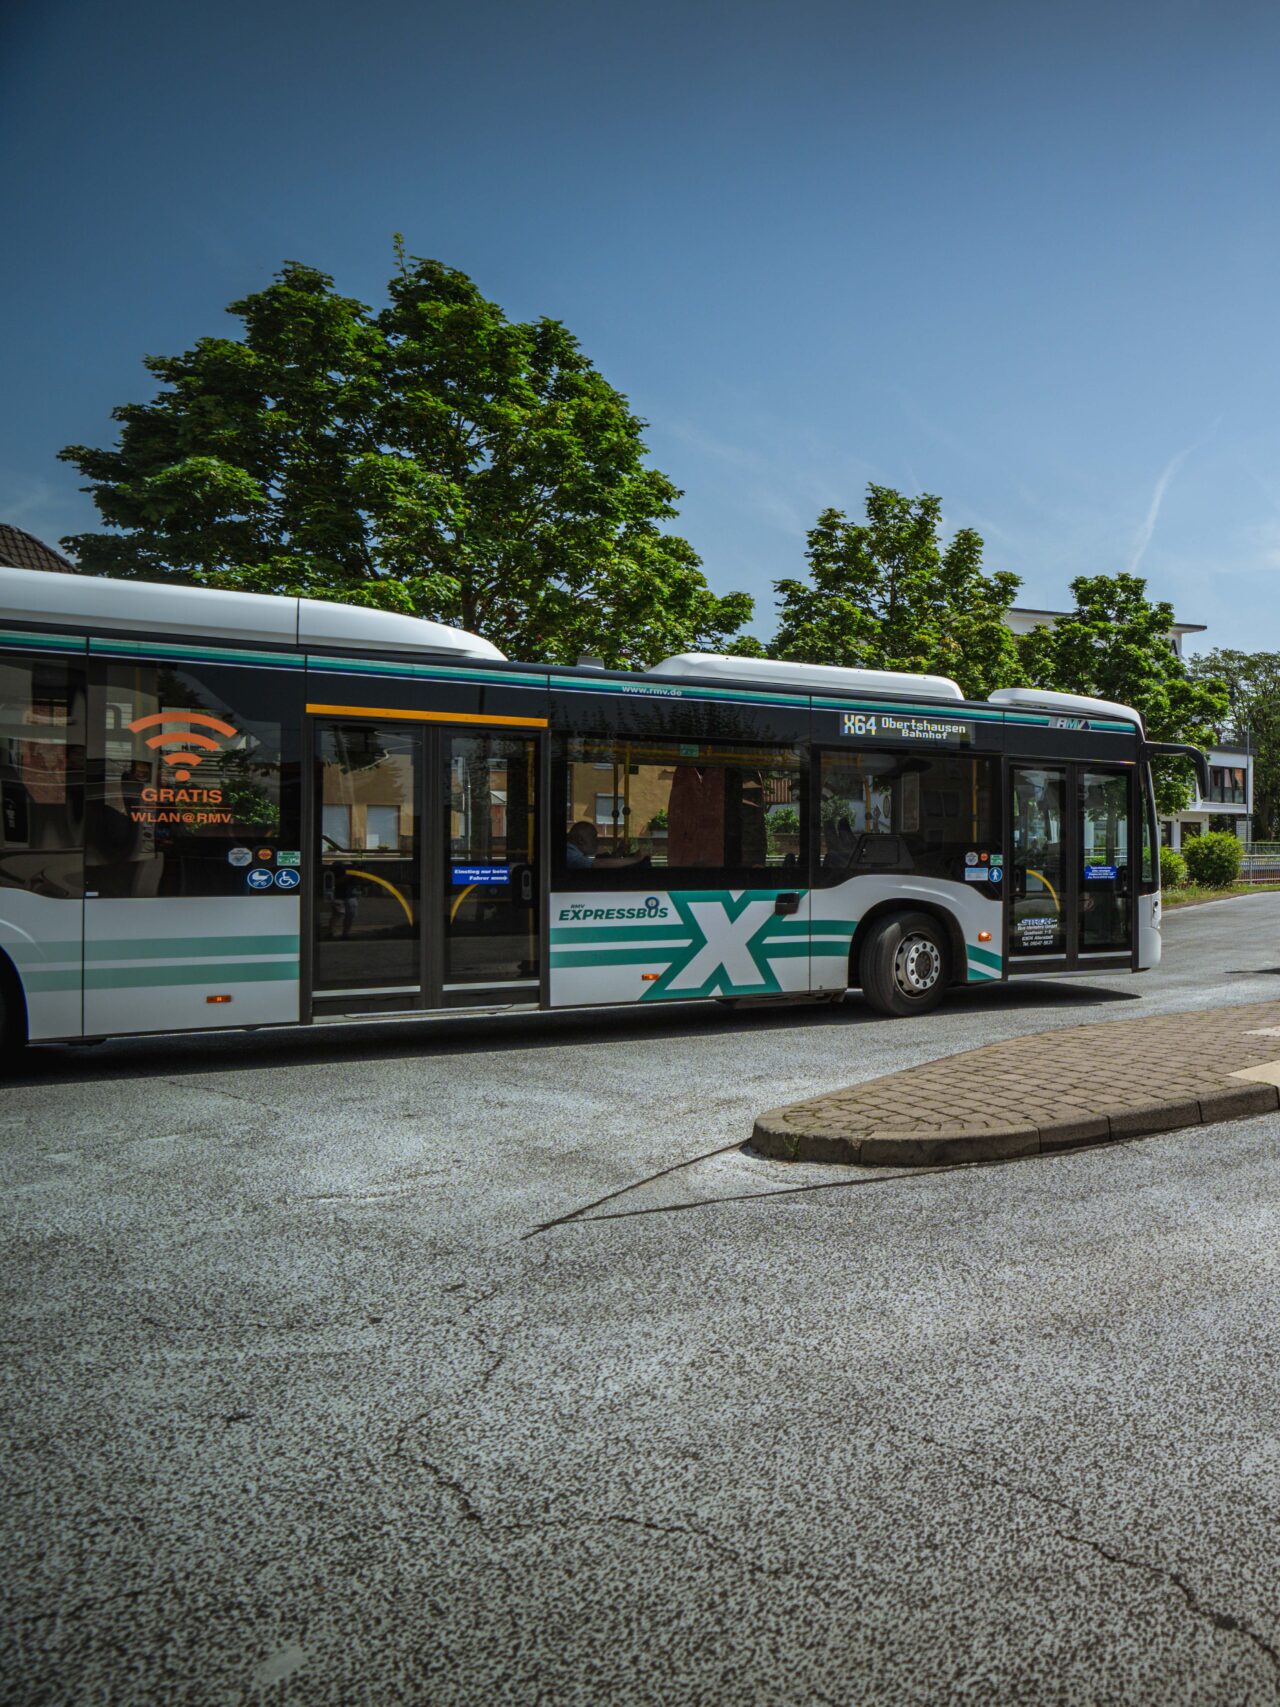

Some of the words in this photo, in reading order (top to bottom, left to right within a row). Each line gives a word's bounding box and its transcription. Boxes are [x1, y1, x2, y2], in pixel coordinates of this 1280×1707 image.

[843, 714, 877, 736] X64
[881, 717, 966, 733] Obertshausen
[901, 728, 948, 740] Bahnhof
[141, 787, 223, 804] GRATIS
[130, 811, 232, 824] WLAN@RMV
[558, 906, 669, 921] EXPRESSBUS
